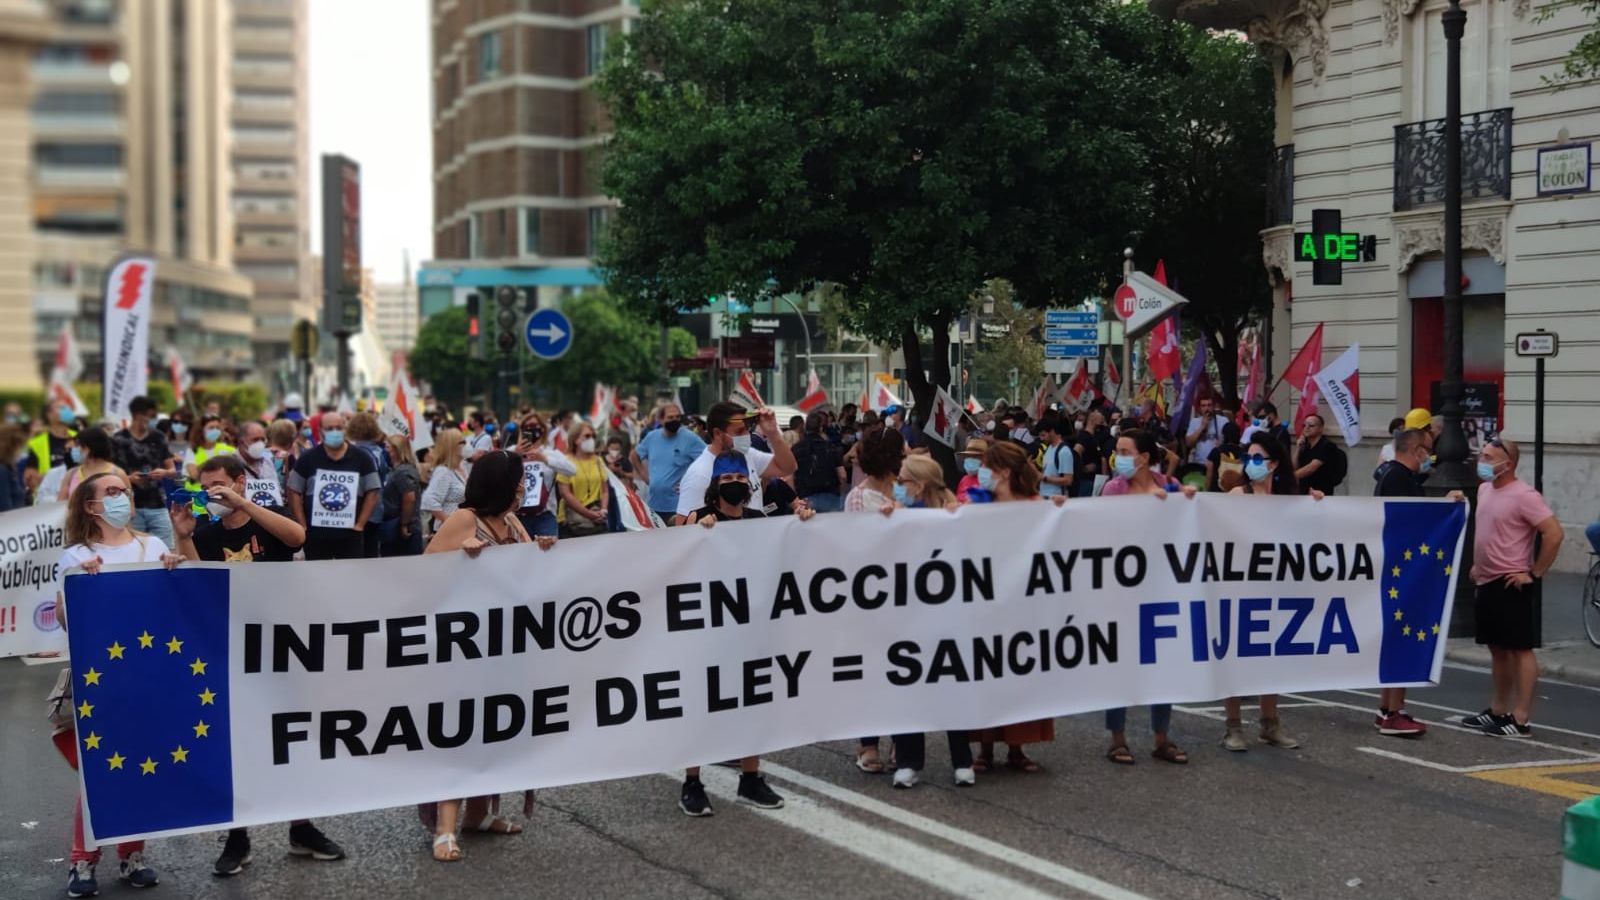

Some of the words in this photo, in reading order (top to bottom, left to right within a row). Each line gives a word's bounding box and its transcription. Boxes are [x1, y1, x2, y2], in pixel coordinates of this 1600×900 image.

[1301, 234, 1318, 259] A
[1324, 234, 1357, 260] DE
[1138, 297, 1162, 310] Colón
[109, 312, 140, 414] INTERSINDICAL
[1327, 377, 1359, 429] endavant
[247, 481, 276, 491] AÑOS
[320, 473, 355, 484] AÑOS
[324, 491, 346, 503] 24
[0, 523, 64, 556] oralita
[0, 560, 59, 590] úblique
[244, 590, 642, 674] INTERIN@S
[666, 577, 751, 633] EN
[769, 548, 995, 620] ACCIÓN
[1025, 545, 1148, 597] AYTO
[1163, 541, 1376, 584] VALENCIA
[271, 684, 571, 766] FRAUDE
[595, 670, 684, 728] DE
[706, 650, 813, 714] LEY
[832, 654, 864, 683] =
[885, 614, 1119, 687] SANCIÓN
[1138, 596, 1361, 666] FIJEZA
